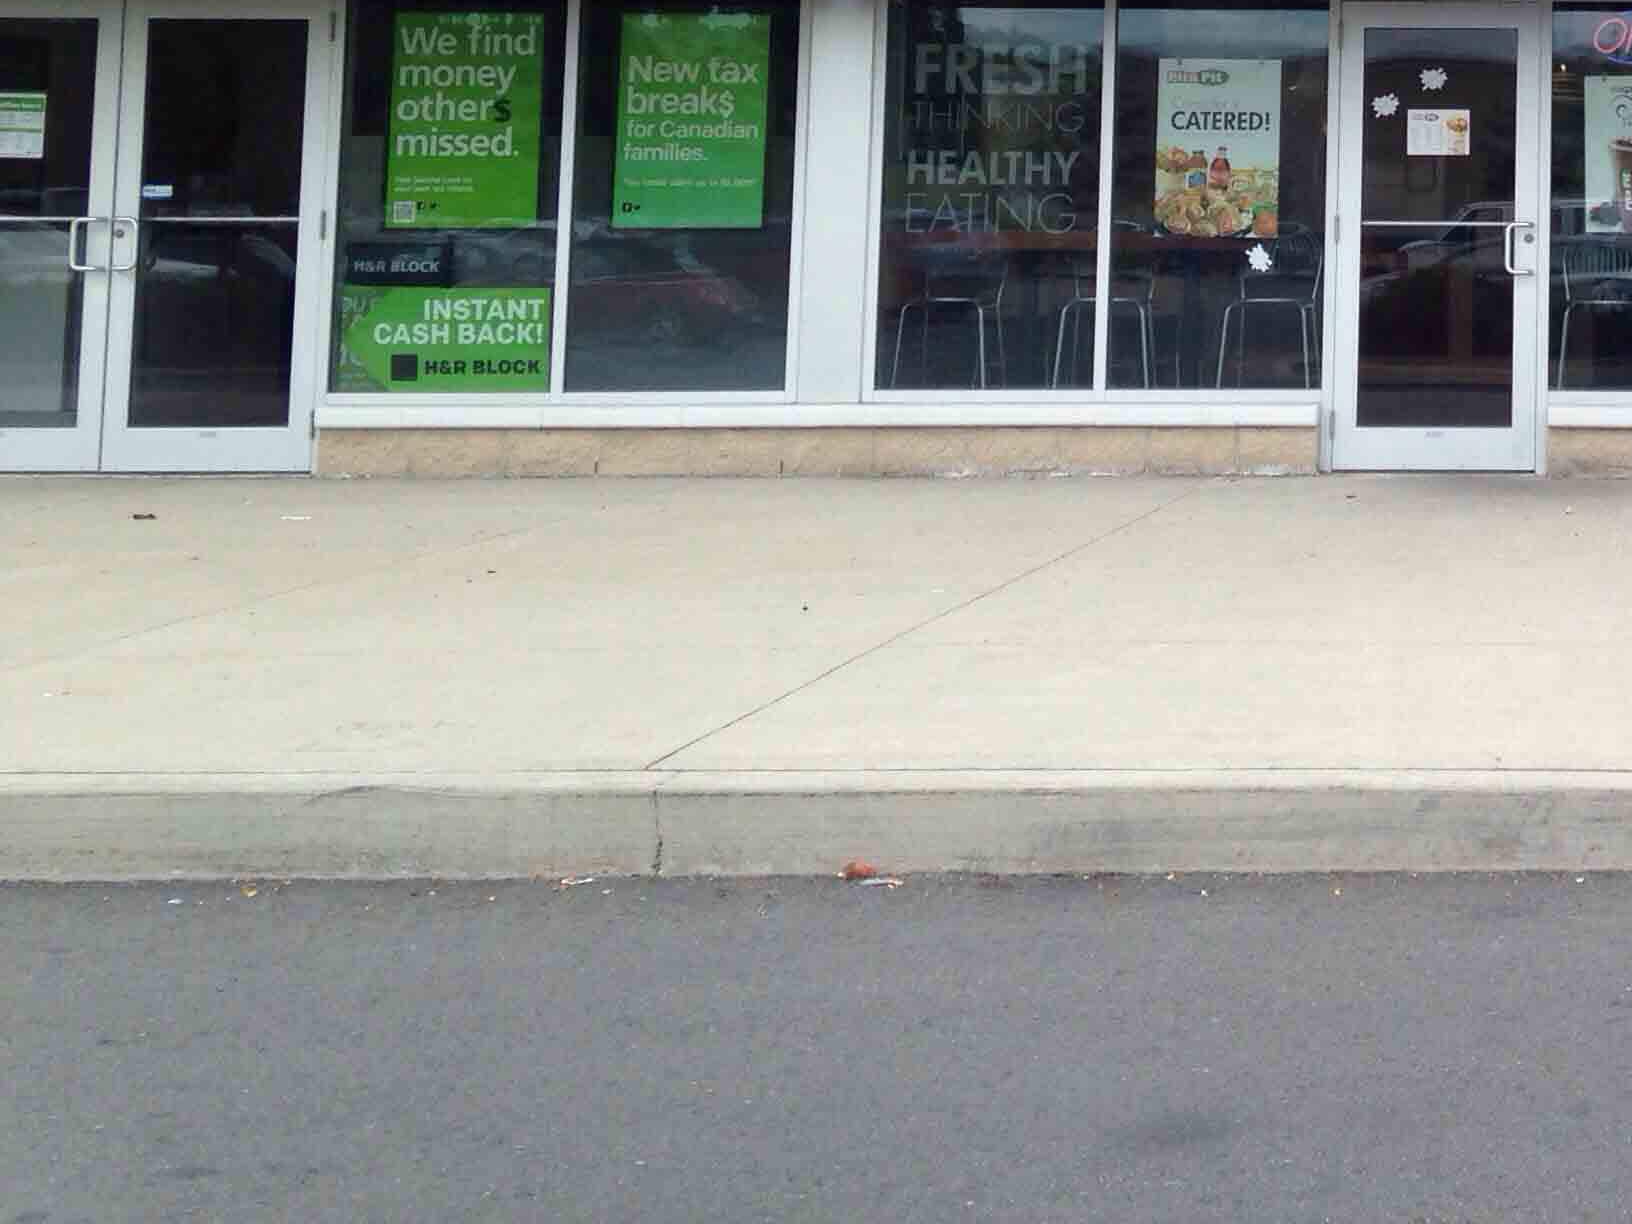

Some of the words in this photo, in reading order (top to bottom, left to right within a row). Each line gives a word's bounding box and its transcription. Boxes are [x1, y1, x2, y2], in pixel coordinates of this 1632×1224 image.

[401, 25, 457, 56] We
[466, 24, 537, 56] find
[399, 63, 517, 96] money
[627, 55, 700, 83] New
[707, 56, 760, 83] tax
[915, 42, 1087, 95] FRESH
[625, 120, 657, 138] for
[660, 119, 759, 139] Canadian
[911, 101, 1085, 132] THINKING
[1170, 110, 1271, 132] CATERED!
[396, 126, 519, 157] missed.
[623, 142, 708, 161] families.
[907, 150, 1081, 185] HEALTHY
[904, 192, 1077, 235] EATING
[353, 259, 387, 273] H&R
[390, 260, 441, 273] BLOCK
[423, 298, 545, 322] INSTANT
[373, 322, 450, 345] CASH
[457, 322, 545, 345] BACK!
[424, 359, 467, 376] H&R
[472, 359, 541, 376] BLOCK
